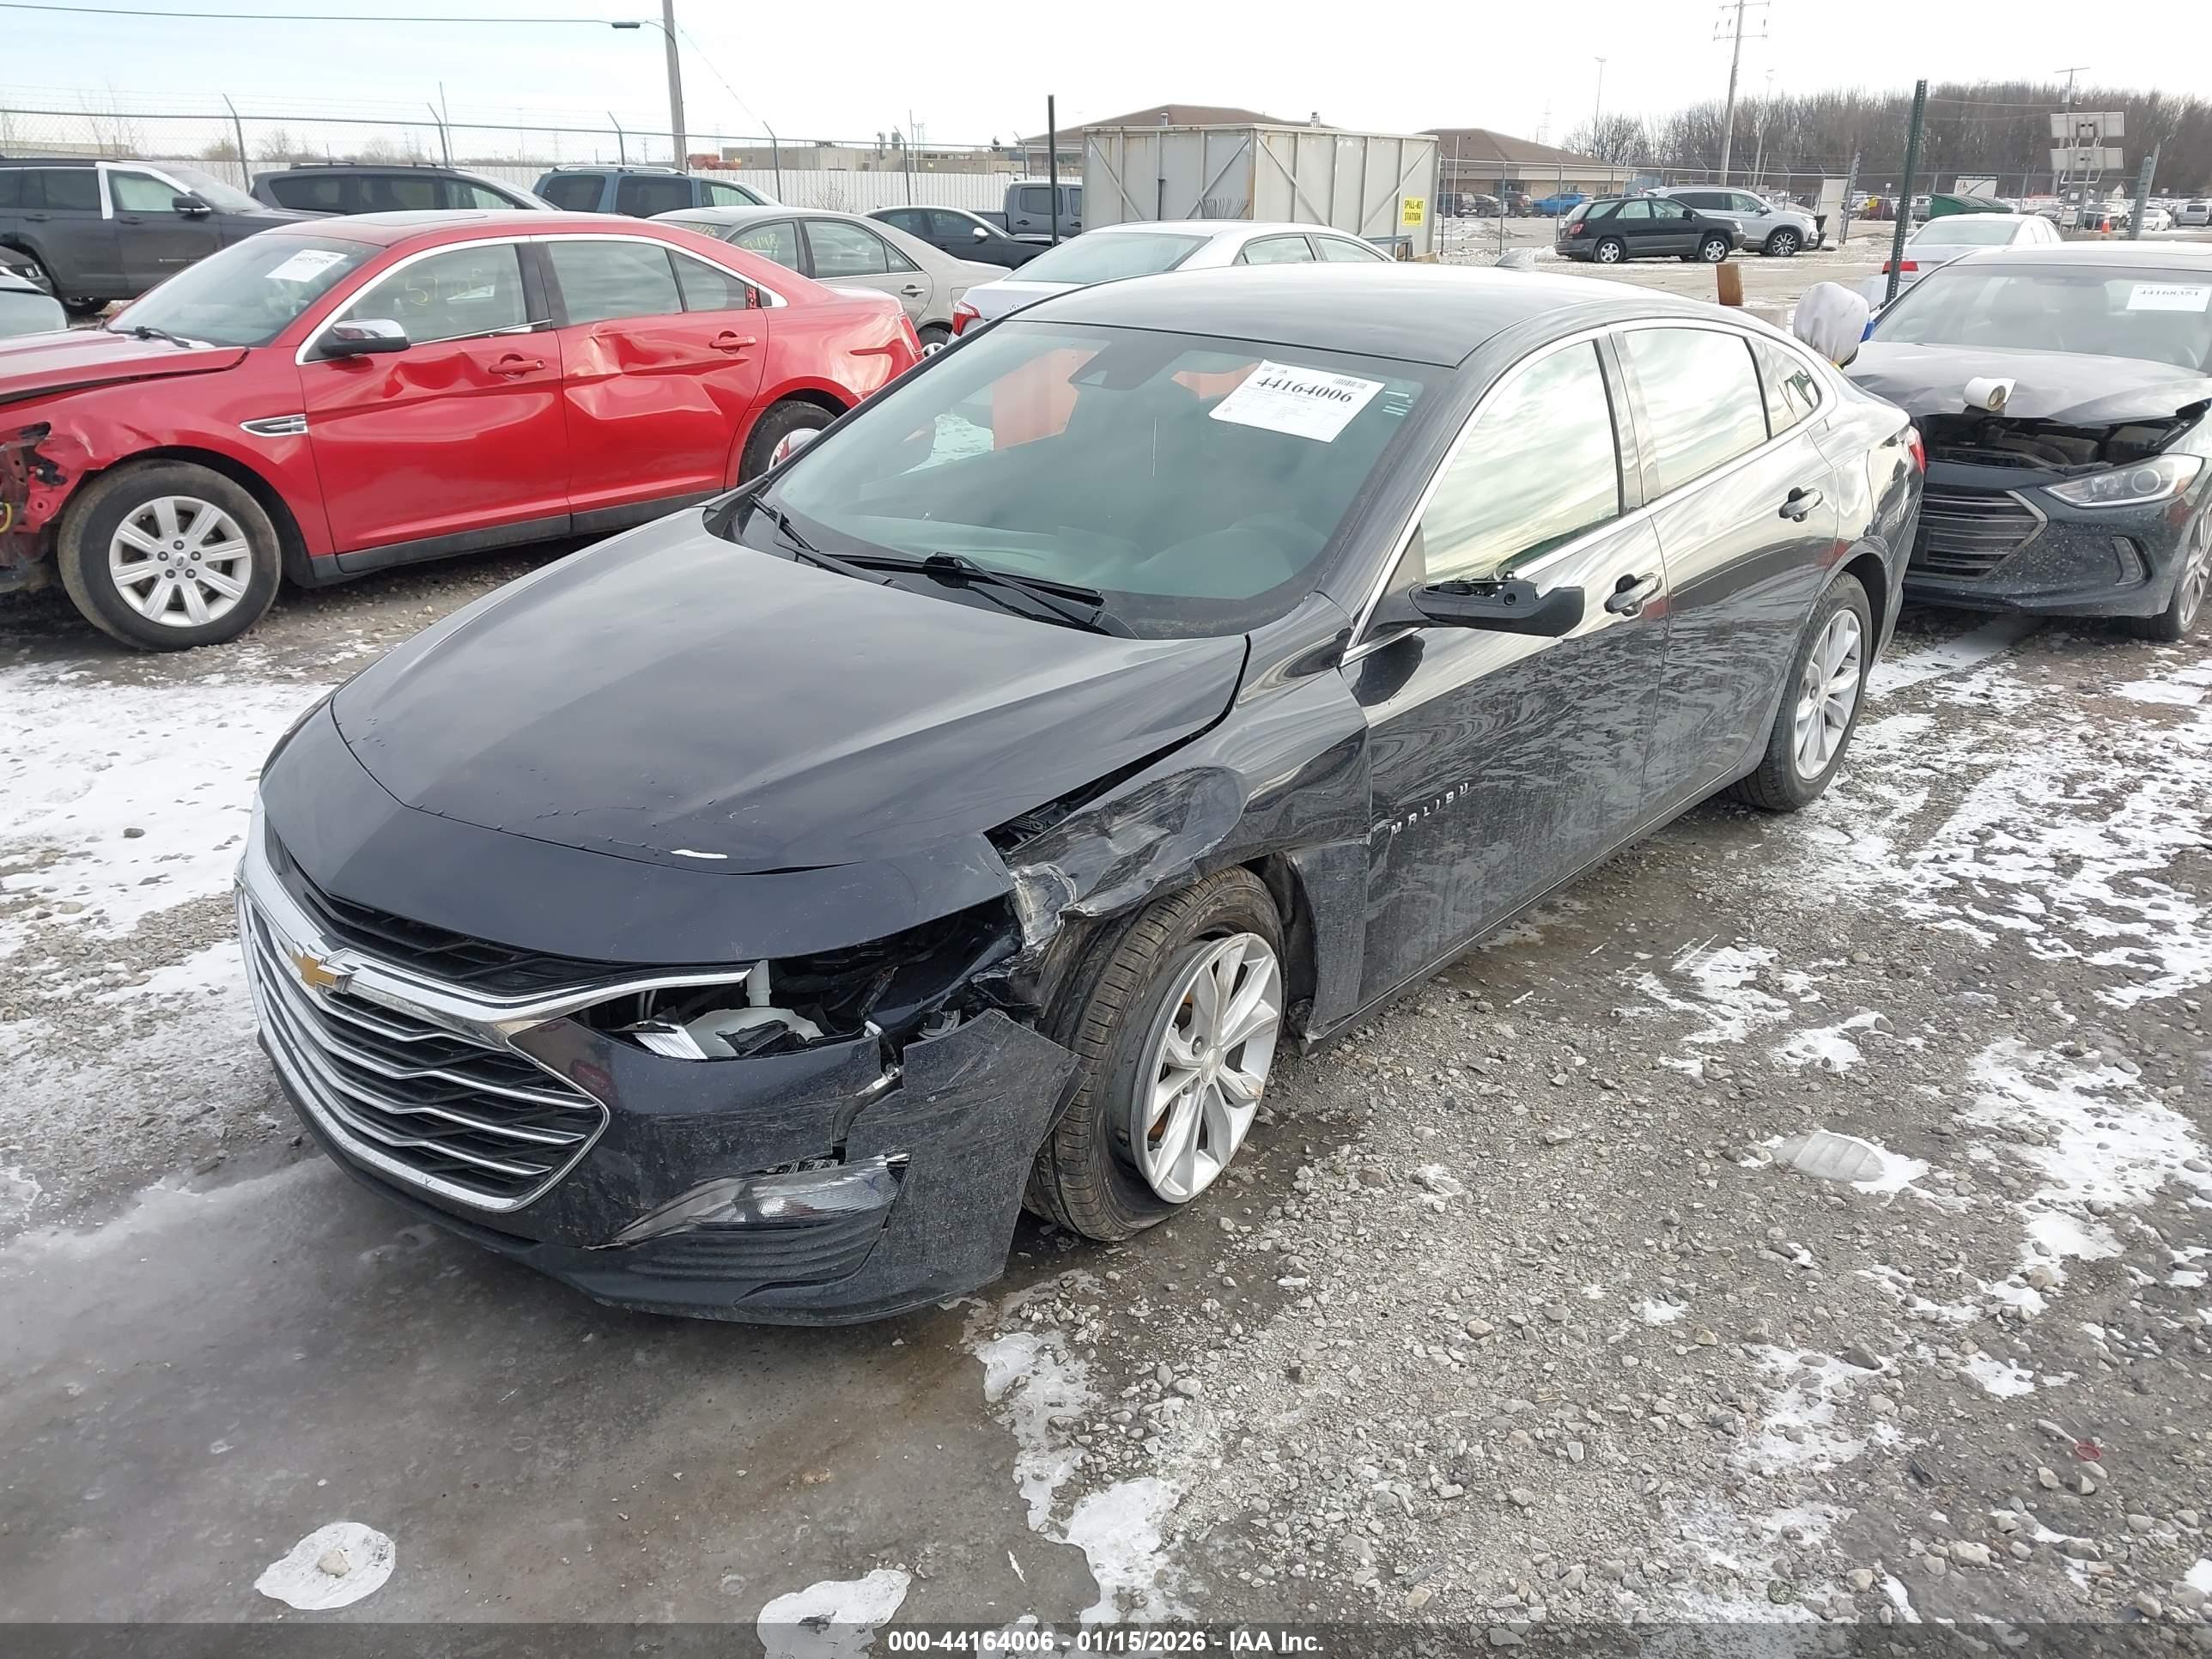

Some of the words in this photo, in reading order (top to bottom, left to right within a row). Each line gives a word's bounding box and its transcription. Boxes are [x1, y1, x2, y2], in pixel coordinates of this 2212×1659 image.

[1404, 199, 1424, 210] SPILL-KIT
[1404, 212, 1421, 221] STATION
[1257, 377, 1357, 403] 44164006
[1390, 782, 1468, 835] MALIBU
